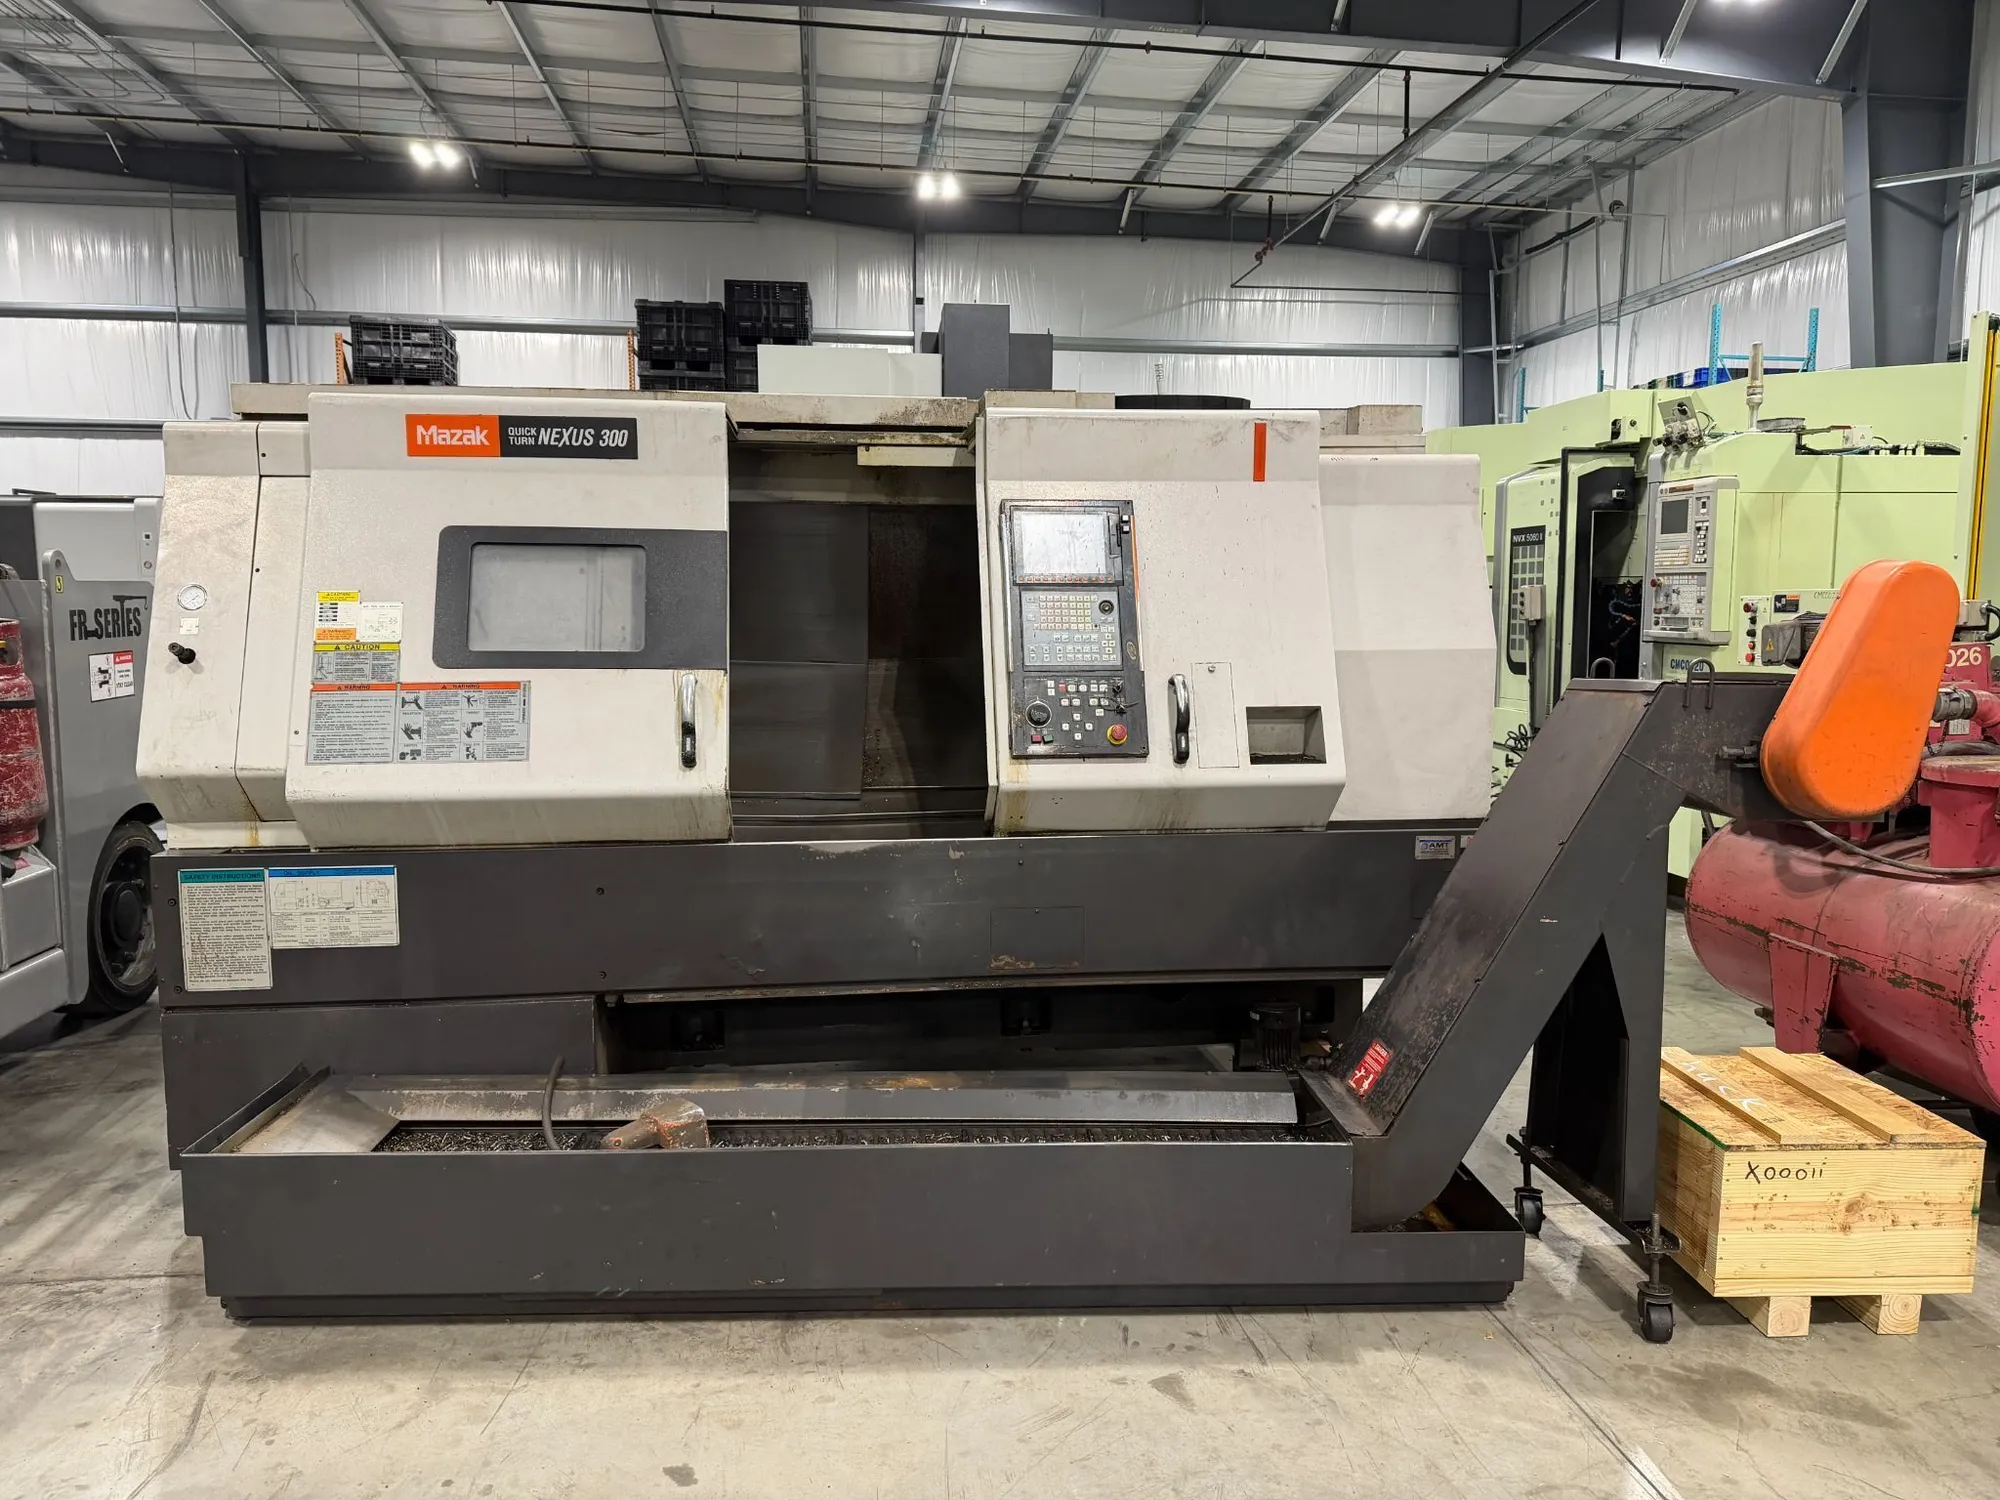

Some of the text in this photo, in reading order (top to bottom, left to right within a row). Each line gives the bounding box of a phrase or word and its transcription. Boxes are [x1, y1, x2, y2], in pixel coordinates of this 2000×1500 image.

[416, 424, 490, 446] Mazak
[508, 427, 537, 436] QUICK
[538, 426, 629, 447] NEXUS 300
[508, 436, 535, 445] TURN
